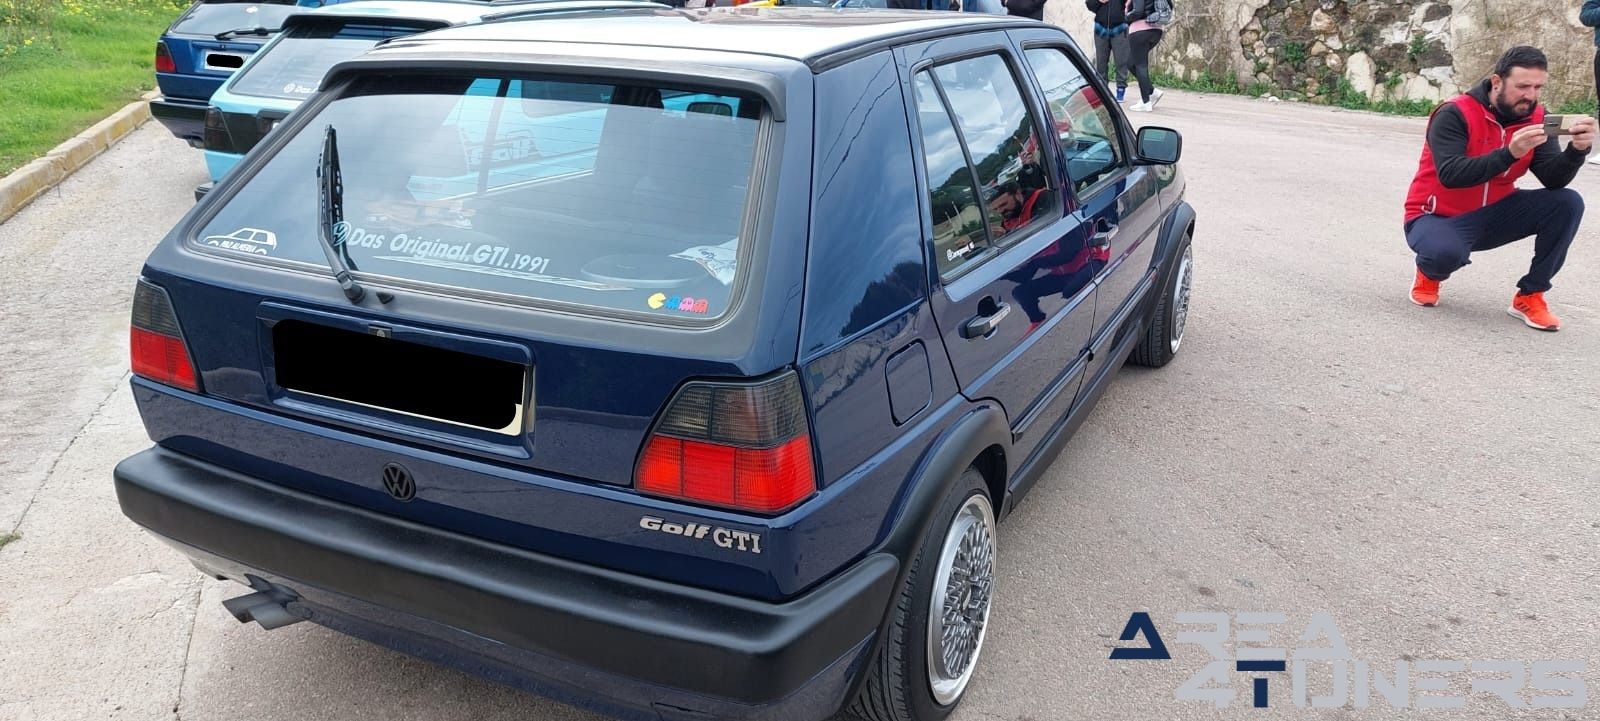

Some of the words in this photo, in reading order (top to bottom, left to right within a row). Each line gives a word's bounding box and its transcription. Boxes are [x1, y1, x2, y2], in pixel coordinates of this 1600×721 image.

[347, 228, 385, 249] Das
[639, 515, 712, 539] Golf
[713, 527, 761, 554] GTI
